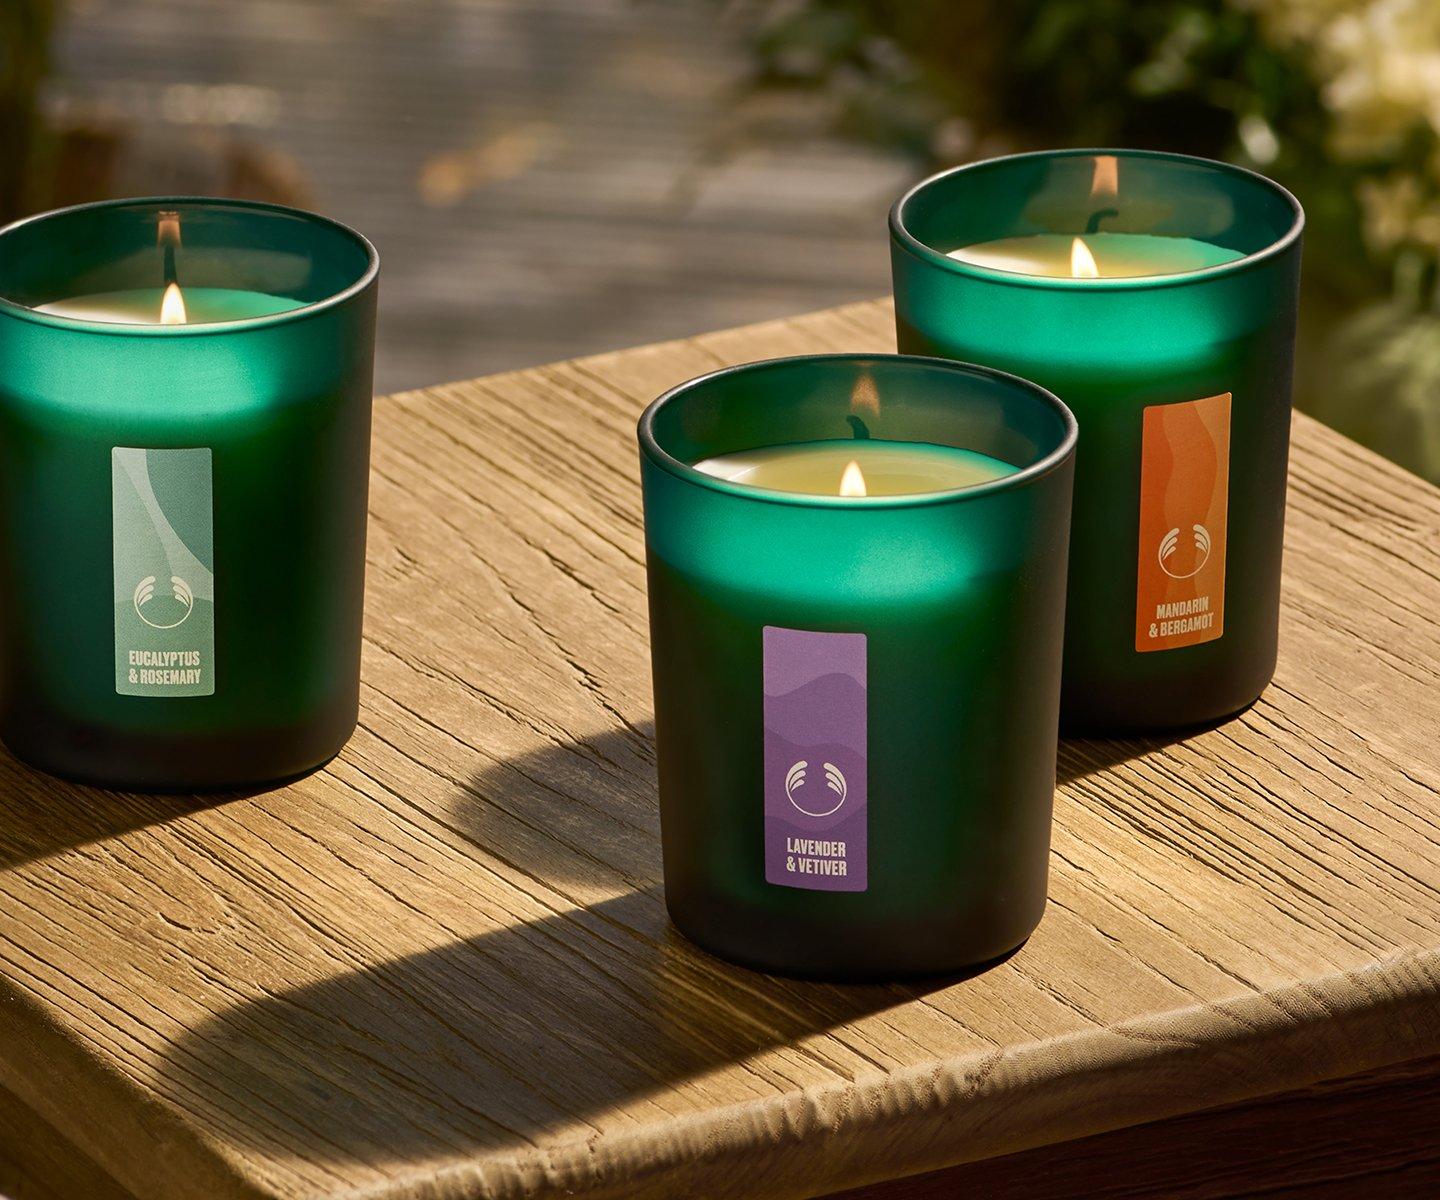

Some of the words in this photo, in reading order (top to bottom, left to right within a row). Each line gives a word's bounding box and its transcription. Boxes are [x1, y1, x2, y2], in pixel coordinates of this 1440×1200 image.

[1156, 596, 1209, 619] MANDARIN
[1148, 622, 1158, 638] &
[1160, 612, 1214, 637] BERGAMOT
[128, 650, 200, 666] EUCALYPTUS
[128, 668, 138, 684] &
[140, 668, 201, 684] ROSEMARY
[787, 837, 846, 857] LAVENDER
[786, 856, 796, 872] &
[798, 857, 847, 876] VETIVER
